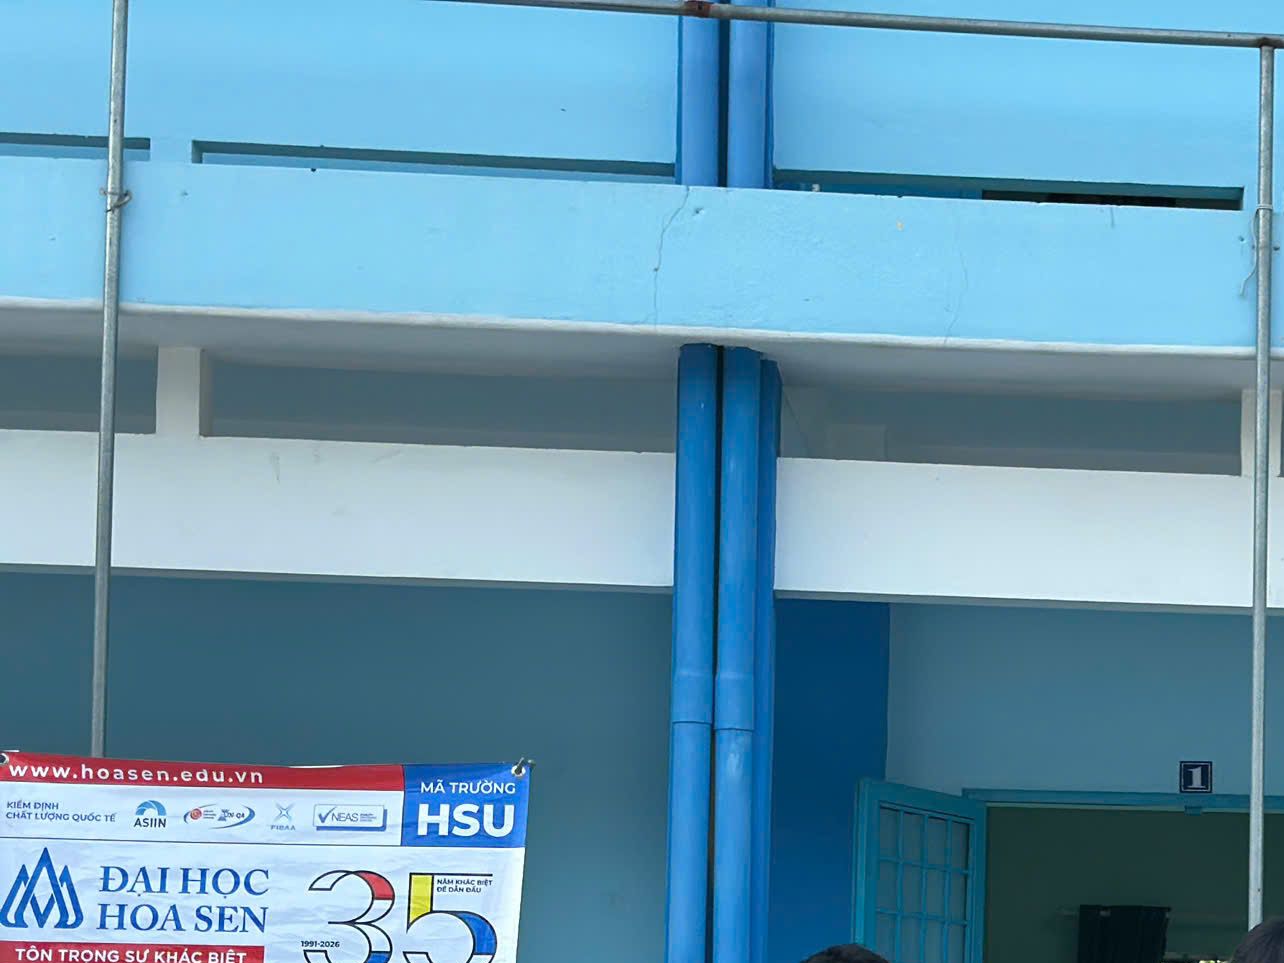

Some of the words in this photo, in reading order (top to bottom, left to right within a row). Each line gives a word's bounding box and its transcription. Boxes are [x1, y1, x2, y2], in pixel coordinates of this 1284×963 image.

[9, 764, 263, 783] www.hoasen.edu.vn
[1187, 766, 1206, 788] 1
[421, 779, 445, 794] MÃ
[450, 780, 516, 795] TRƯỜNG
[134, 818, 166, 828] ASIIN
[332, 813, 359, 822] NEAS
[417, 803, 515, 837] HSU
[99, 866, 170, 897] ĐẠI
[178, 867, 269, 899] HỌC
[96, 903, 186, 931] HOA
[194, 905, 269, 933] SEN
[301, 940, 340, 948] 1991-2026
[15, 945, 52, 961] TÔN
[154, 948, 202, 963] KHÁC
